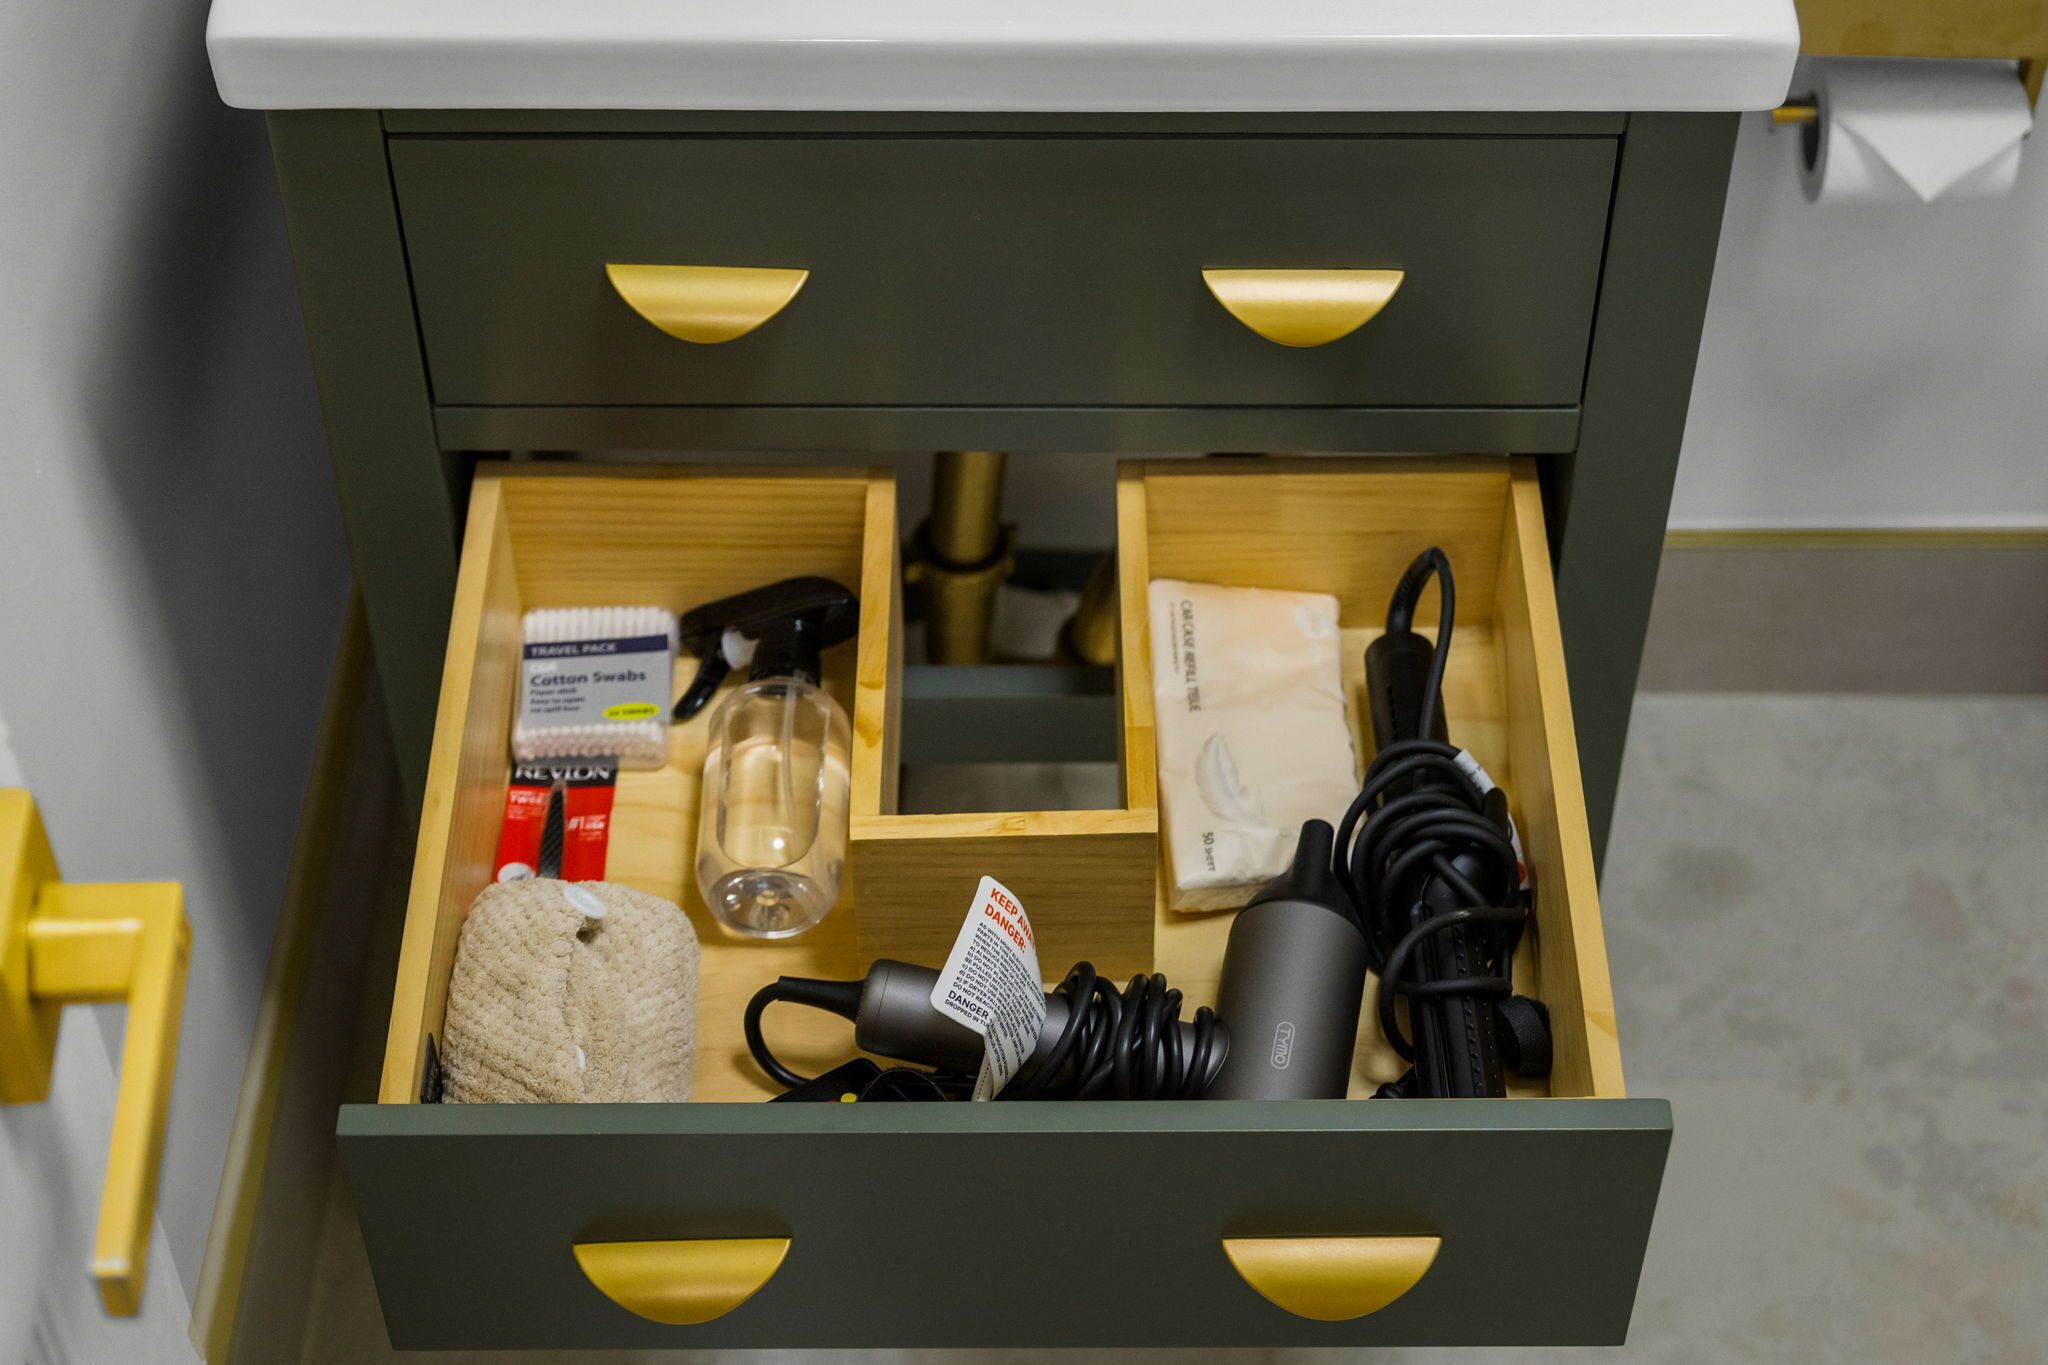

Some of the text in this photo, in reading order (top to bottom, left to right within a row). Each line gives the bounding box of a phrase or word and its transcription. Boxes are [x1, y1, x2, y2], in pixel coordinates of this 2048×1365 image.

[530, 642, 618, 657] TRAVEL PACK
[530, 669, 647, 687] Cotton Swabs
[515, 765, 610, 780] REVLON
[1202, 831, 1215, 845] 50
[990, 888, 1035, 949] KEEP AWA
[985, 903, 1026, 953] DANGER:
[953, 982, 963, 990] DO
[962, 988, 975, 997] NOT
[945, 999, 973, 1018] DROPPED
[948, 990, 990, 1020] DANGER
